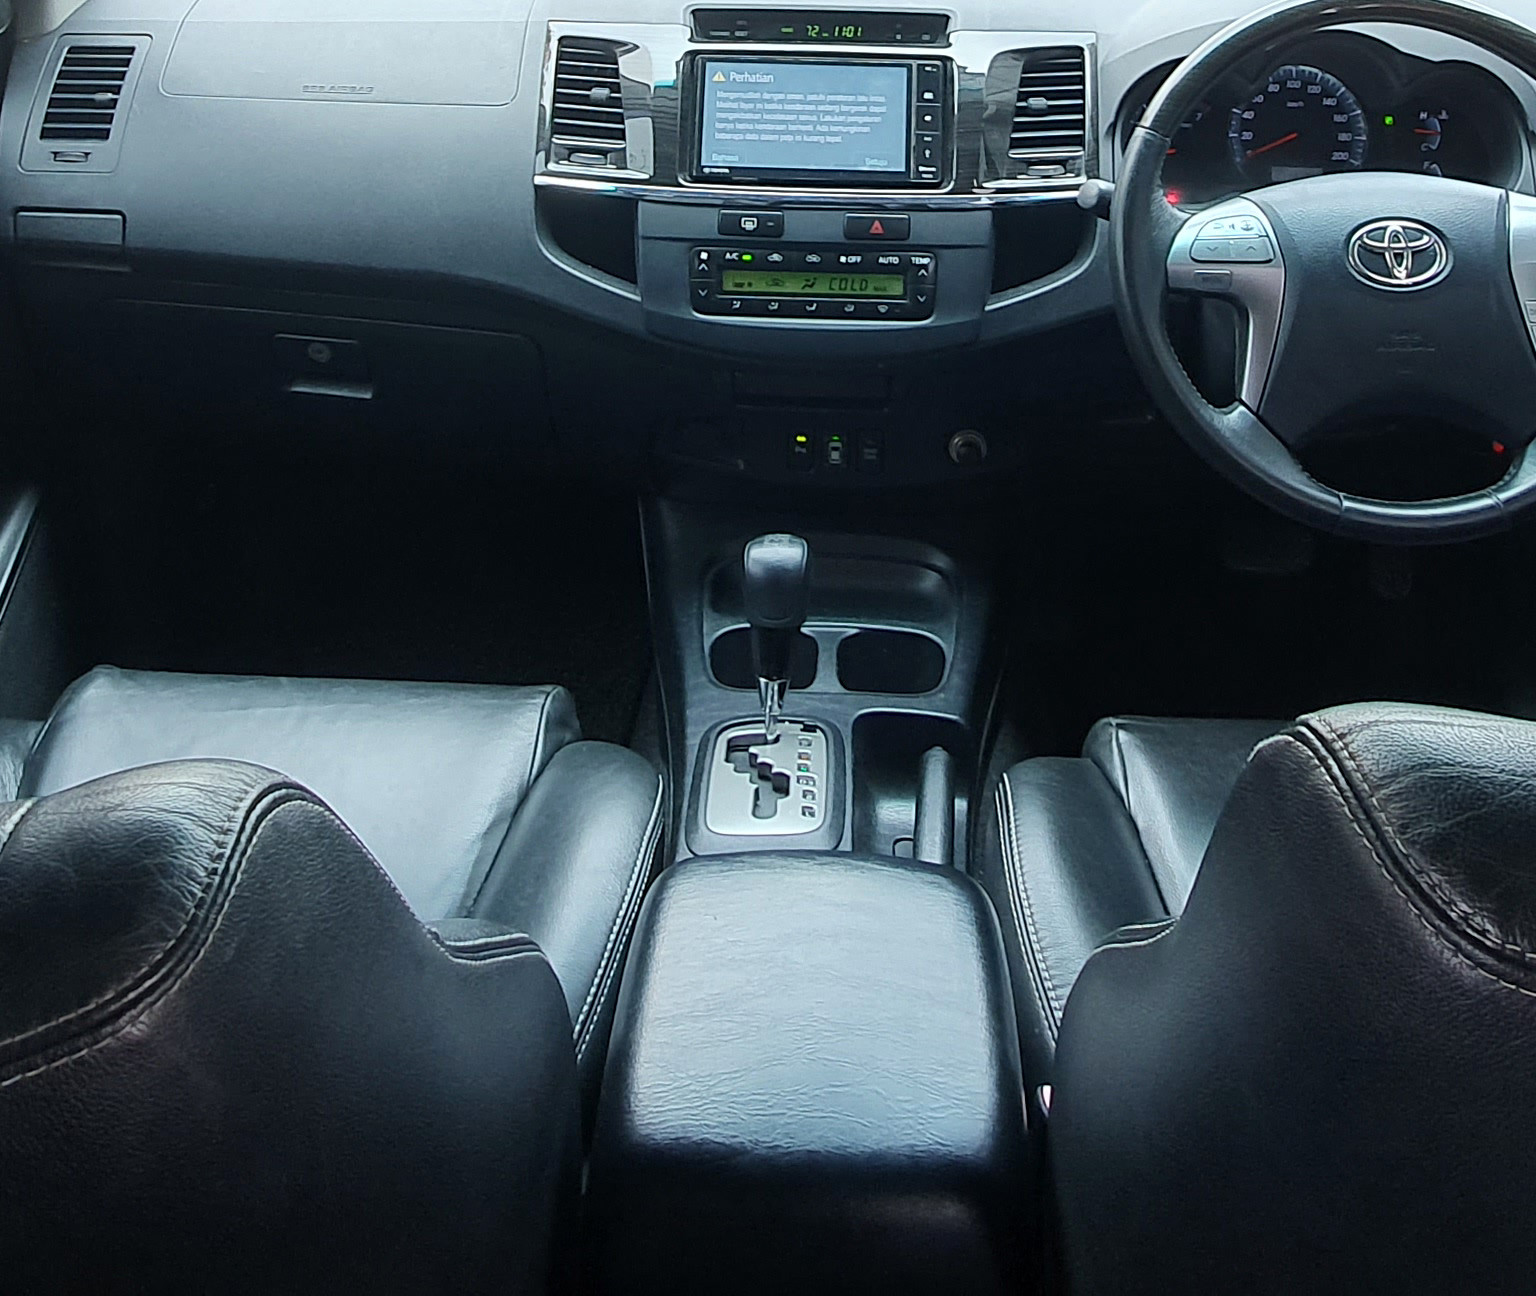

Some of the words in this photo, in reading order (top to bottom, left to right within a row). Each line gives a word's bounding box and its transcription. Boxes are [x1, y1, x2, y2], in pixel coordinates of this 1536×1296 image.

[729, 71, 774, 84] Perhatian
[1287, 80, 1301, 88] 100
[1241, 131, 1254, 140] 20
[1331, 151, 1349, 160] 200
[725, 252, 739, 261] A/C
[847, 255, 862, 264] OFF
[878, 256, 900, 265] AUTO
[910, 256, 931, 265] TEMP
[828, 276, 869, 293] COLD
